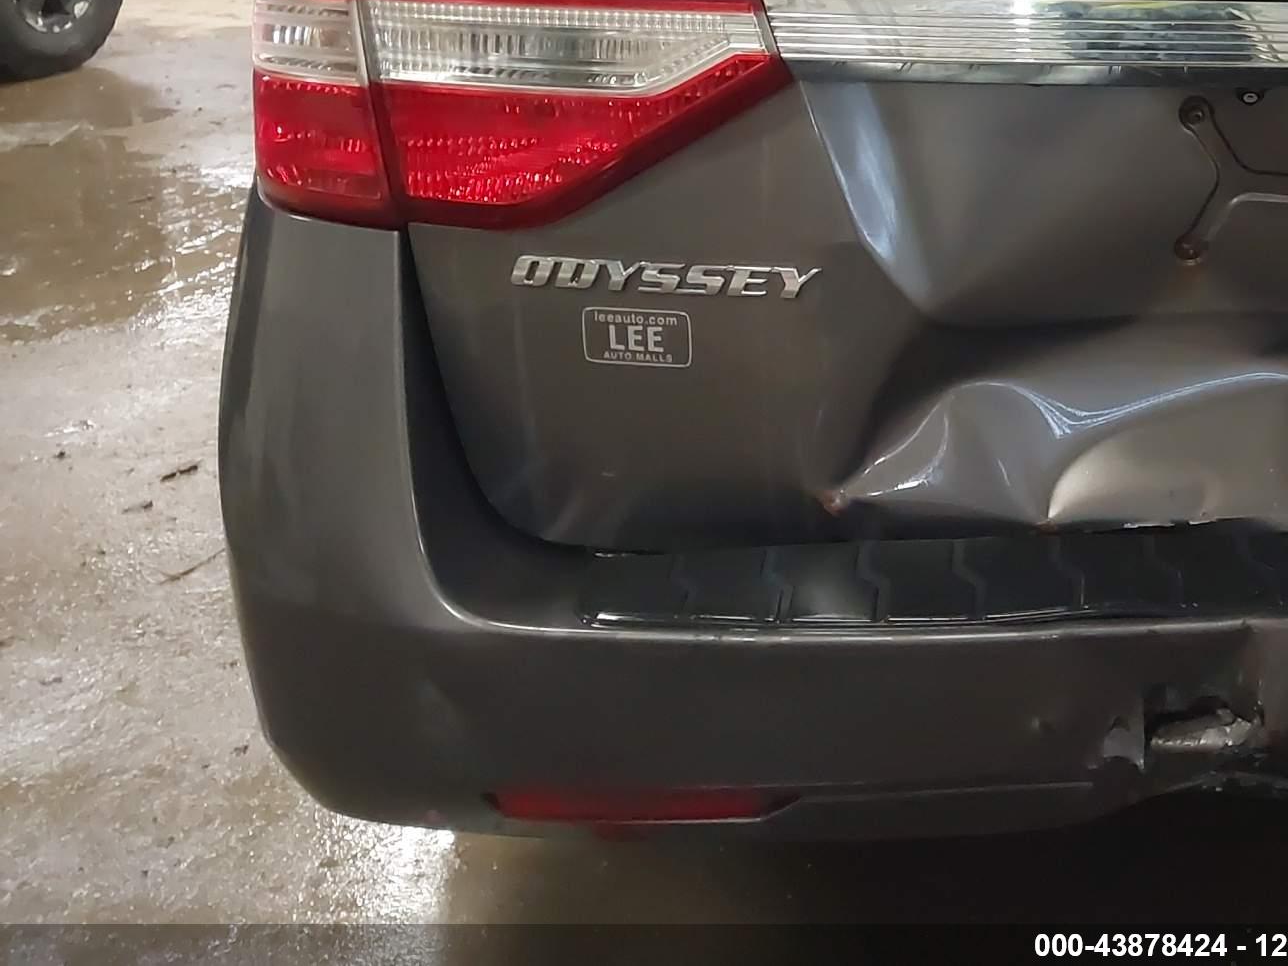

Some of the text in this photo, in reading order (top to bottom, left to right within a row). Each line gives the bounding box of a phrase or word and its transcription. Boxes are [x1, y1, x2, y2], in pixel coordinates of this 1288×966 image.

[510, 254, 823, 300] ODYSSEY
[593, 310, 678, 326] leeauto.com
[608, 324, 665, 353] LEE
[603, 351, 673, 363] AUTO MALLS
